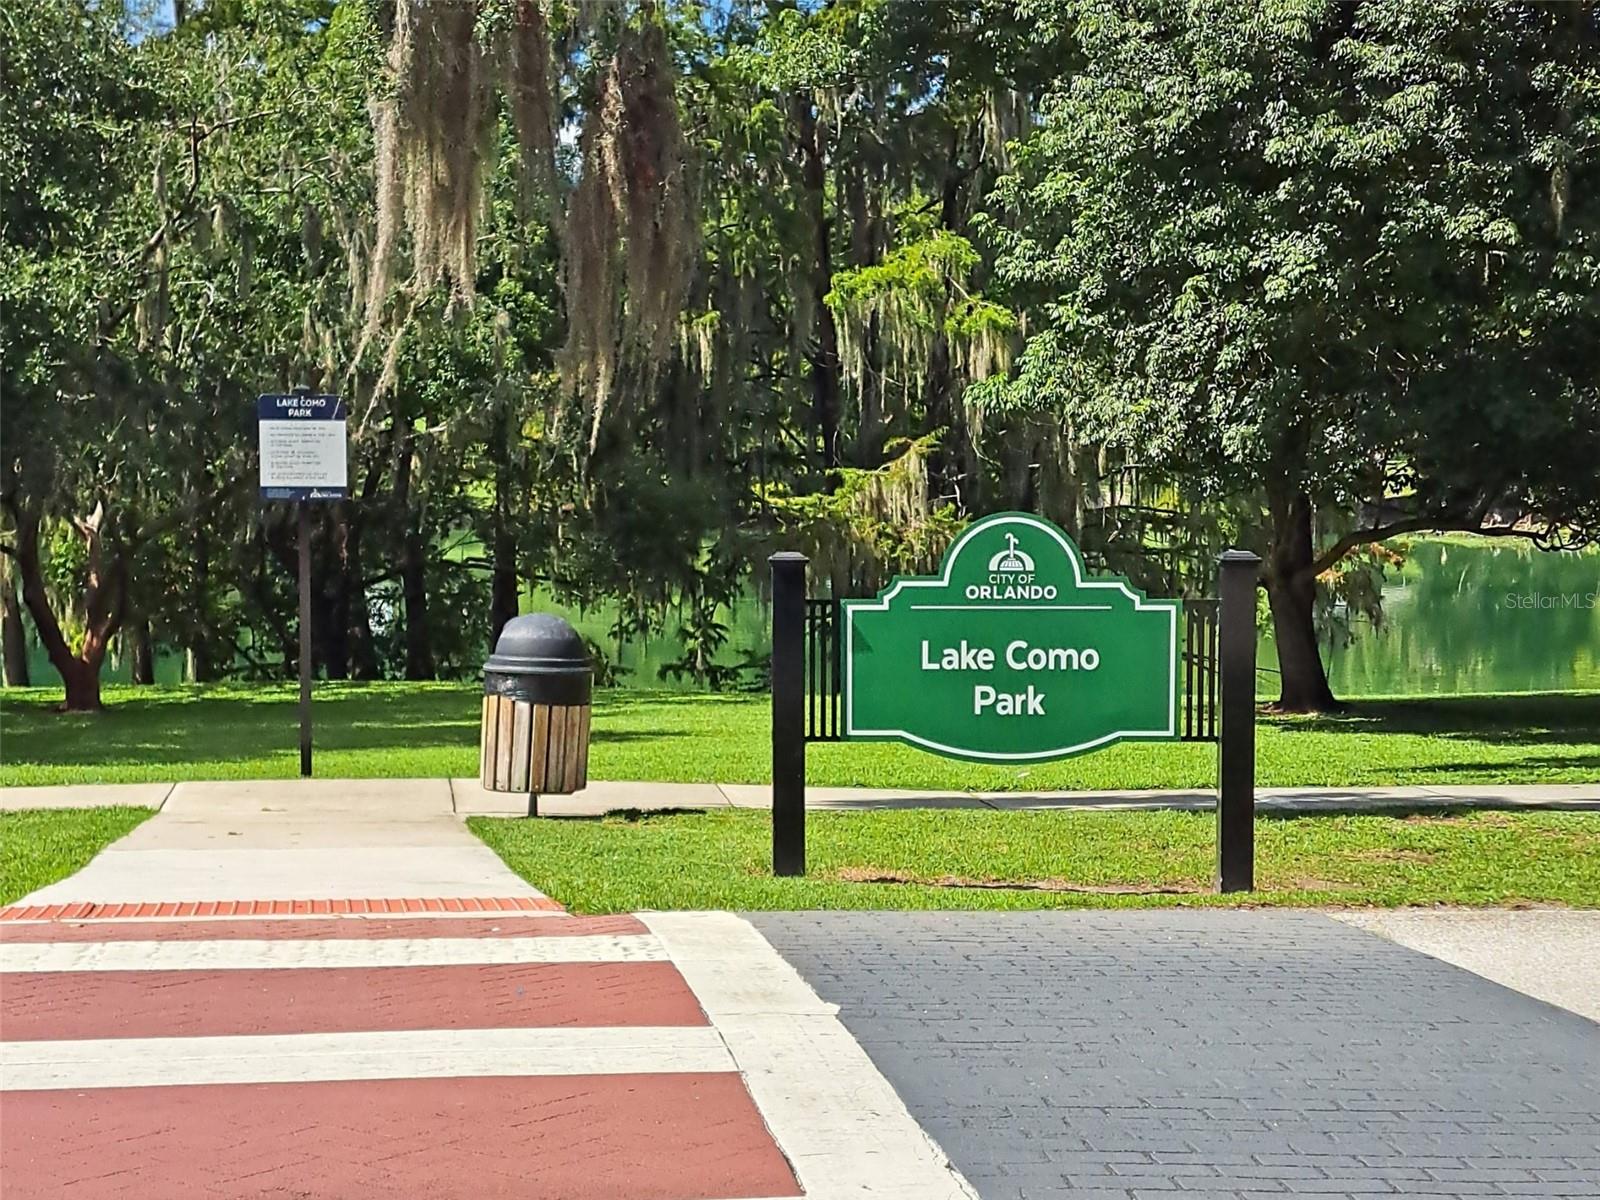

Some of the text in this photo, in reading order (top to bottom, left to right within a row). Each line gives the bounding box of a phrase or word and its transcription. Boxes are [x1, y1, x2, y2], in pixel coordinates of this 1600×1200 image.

[276, 398, 326, 407] LAKE COMO
[288, 409, 312, 417] PARK
[988, 573, 1035, 584] CITY OF
[965, 585, 1057, 600] ORLANDO
[921, 640, 1100, 671] Lake Como
[973, 685, 1046, 716] Park
